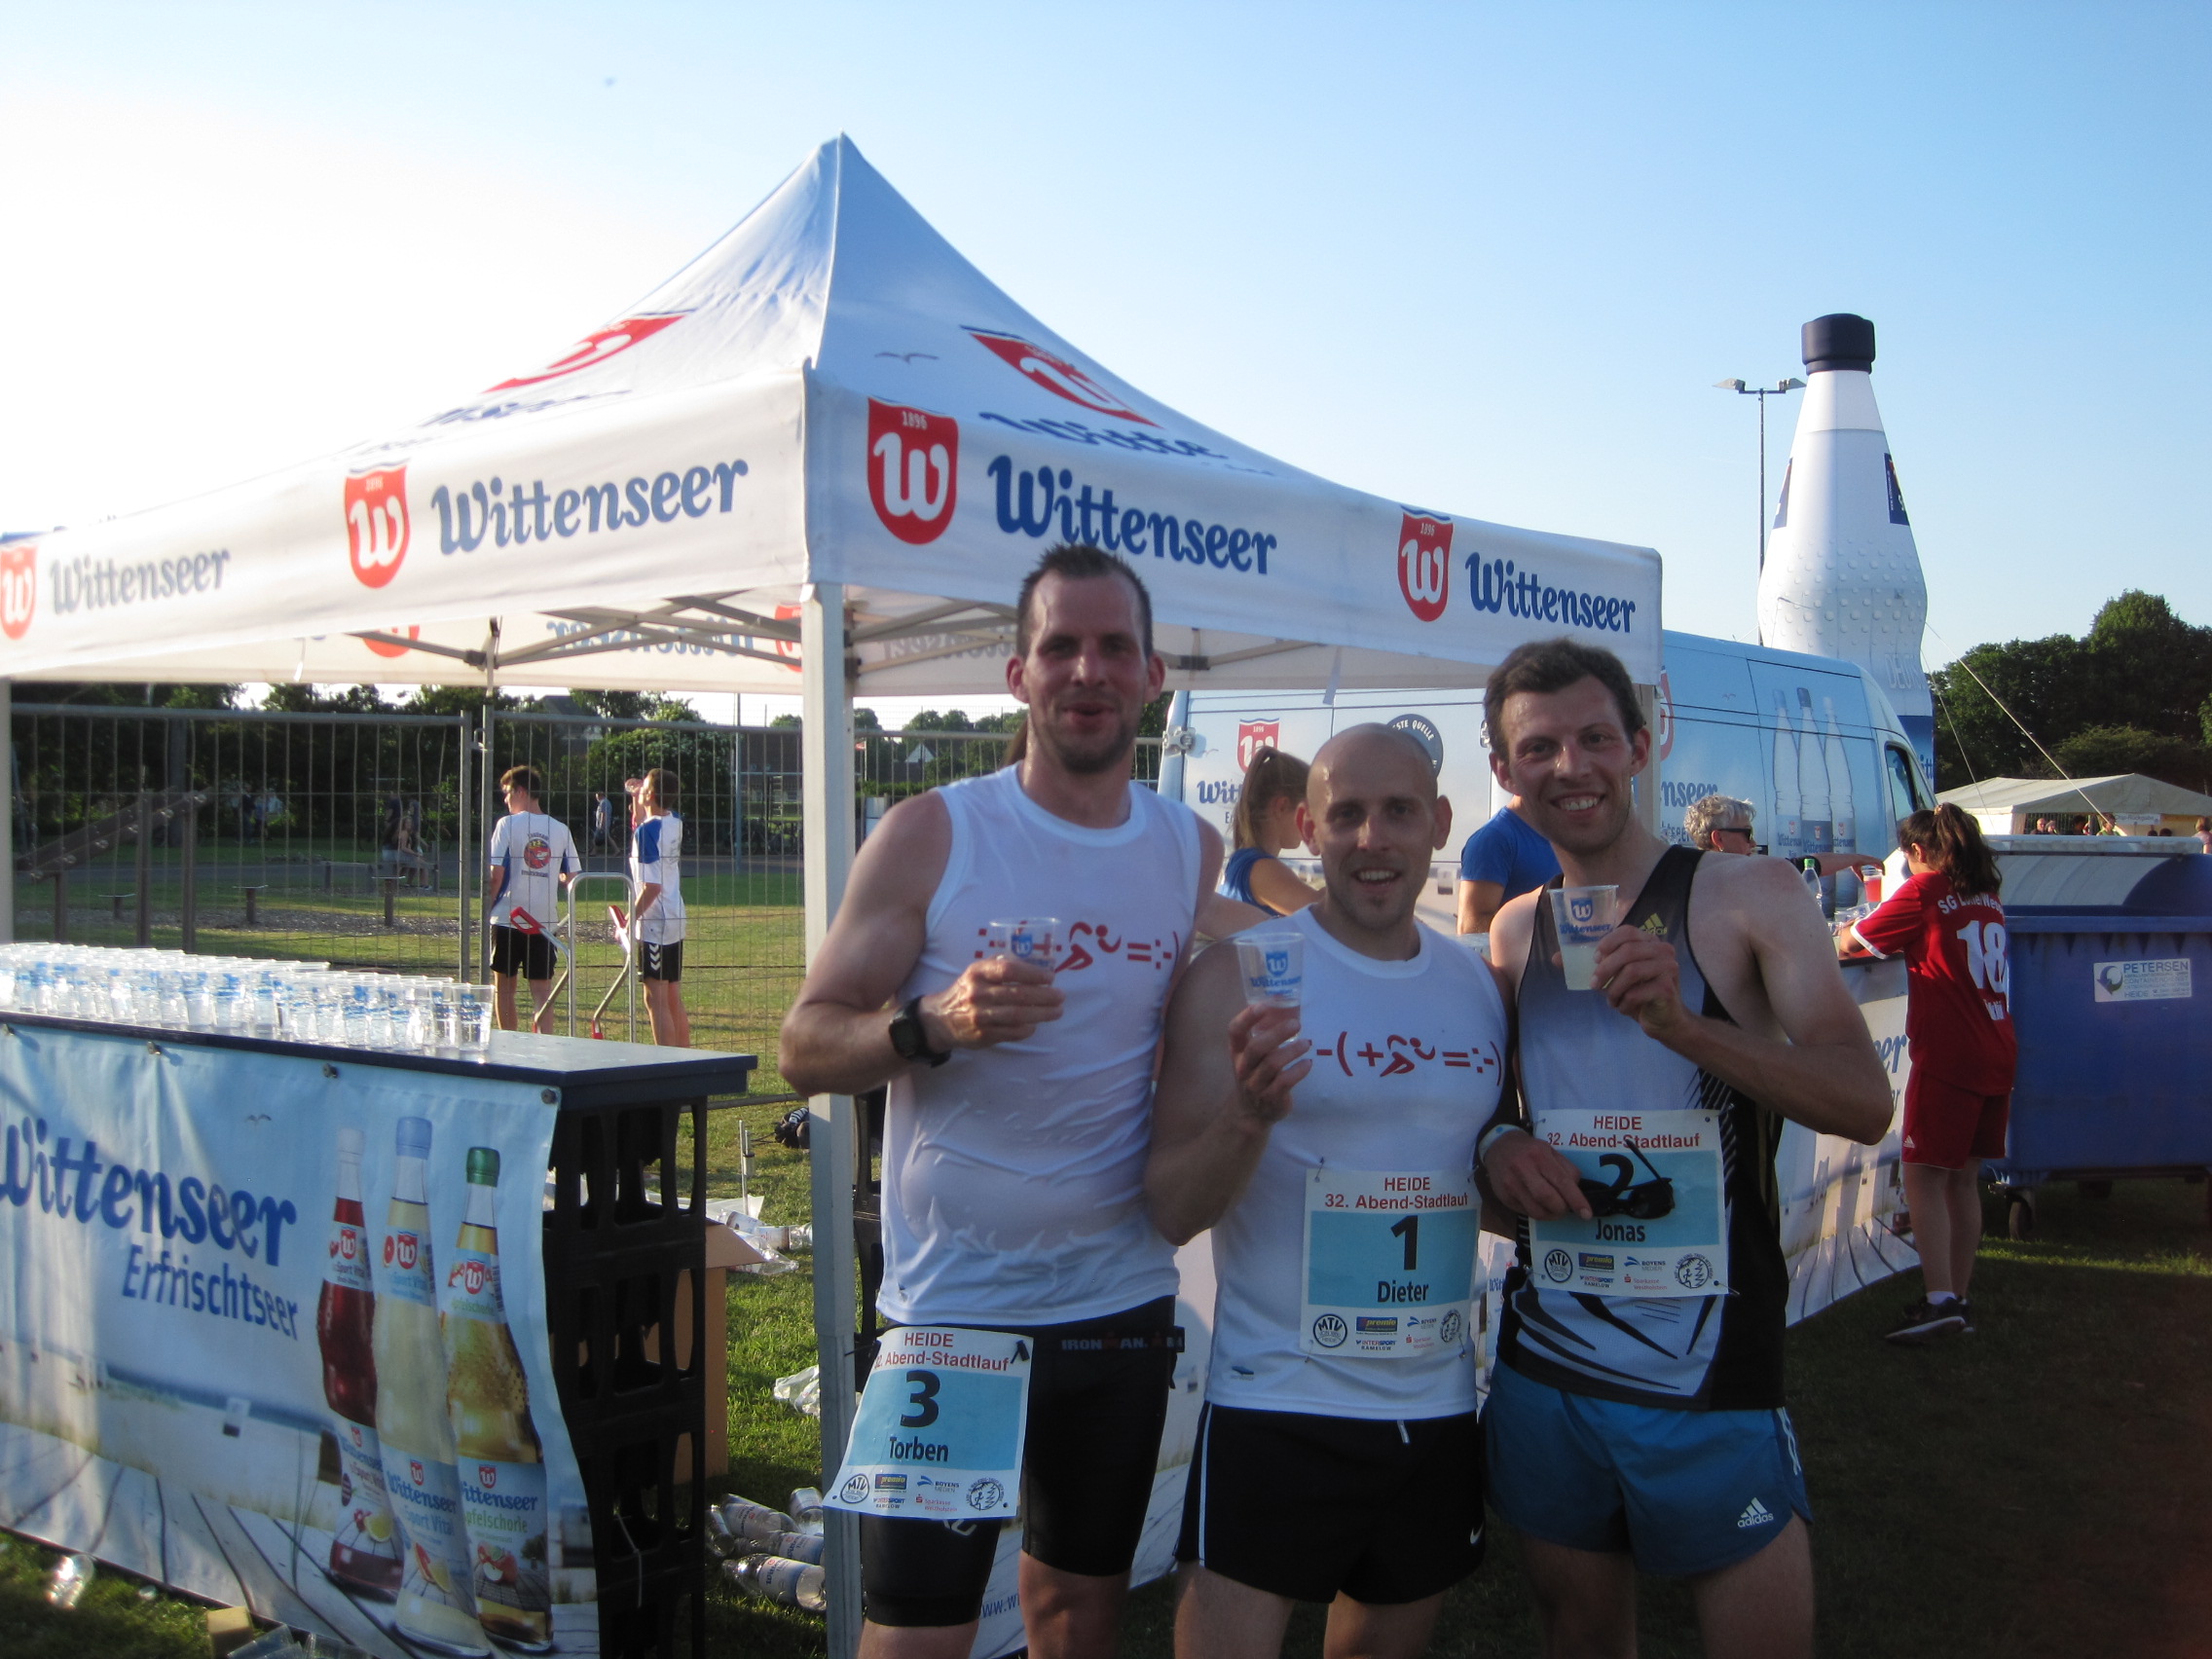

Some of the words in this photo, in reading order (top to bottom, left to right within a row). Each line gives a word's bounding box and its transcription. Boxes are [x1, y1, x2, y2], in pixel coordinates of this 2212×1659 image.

[903, 410, 927, 430] 1896
[431, 459, 749, 556] Wittenseer
[987, 454, 1277, 574] Wittenseer
[1419, 522, 1436, 536] 1896
[50, 547, 231, 615] Wittenseer
[1464, 551, 1636, 634] Wittenseer
[1412, 719, 1435, 742] QUELLE
[1956, 920, 2007, 994] 18
[2123, 960, 2189, 974] PETERSEN
[1593, 1116, 1642, 1130] HEIDE
[1568, 1132, 1700, 1149] Abend-Stadtlauf
[1383, 1177, 1431, 1192] HEIDE
[1324, 1194, 1349, 1208] 32.
[1354, 1192, 1468, 1209] Abend-Stadtlauf
[1595, 1219, 1646, 1243] Jonas
[1390, 1214, 1419, 1271] 1
[1548, 1253, 1568, 1267] MTV
[122, 1243, 299, 1342] Erfrischtseer
[1377, 1279, 1429, 1303] Dieter
[1317, 1317, 1343, 1332] MTV
[1367, 1317, 1396, 1327] premio
[903, 1332, 954, 1348] HEIDE
[885, 1350, 1010, 1372] Abend-Stadtlauf
[900, 1370, 941, 1428] 3
[888, 1436, 949, 1462] Torben
[847, 1476, 867, 1491] MTV
[461, 1480, 538, 1511] ittenseer
[1737, 1511, 1774, 1529] adidas
